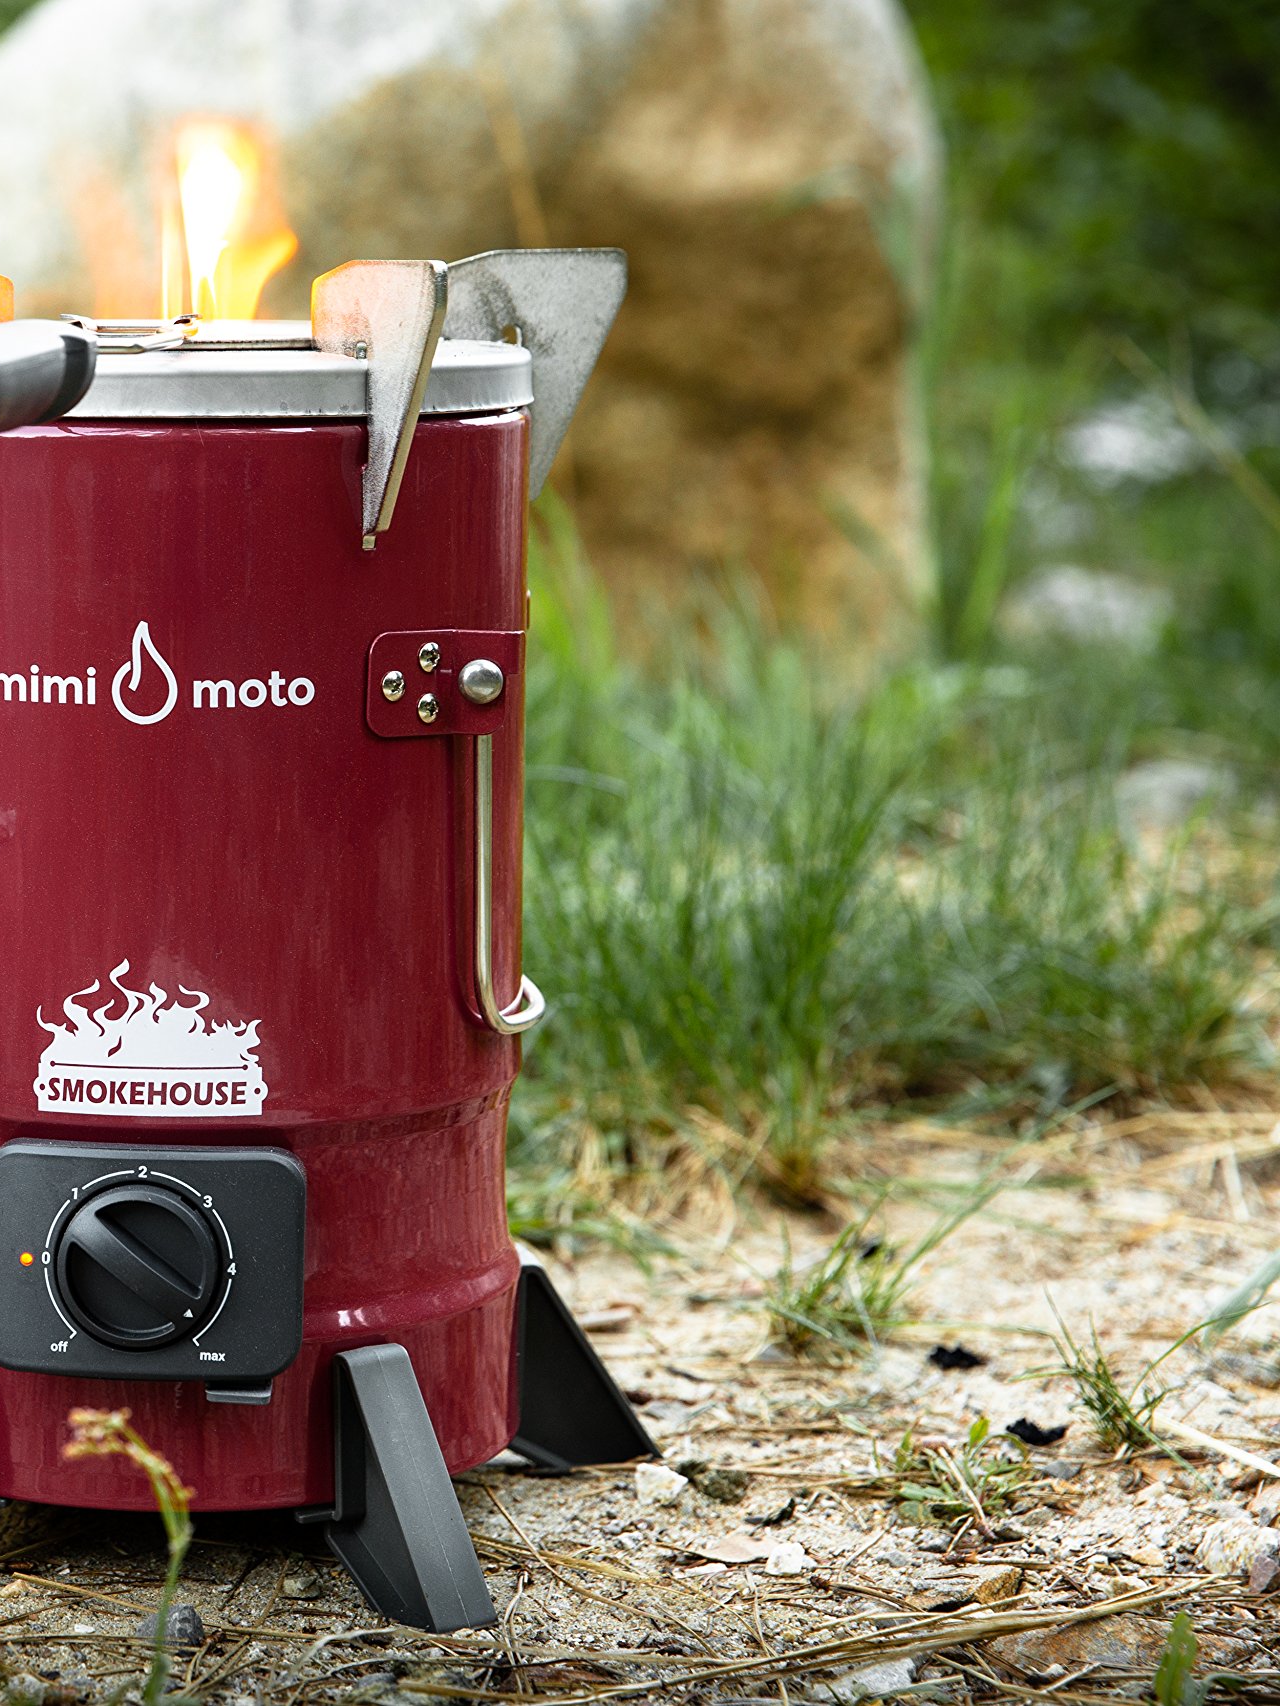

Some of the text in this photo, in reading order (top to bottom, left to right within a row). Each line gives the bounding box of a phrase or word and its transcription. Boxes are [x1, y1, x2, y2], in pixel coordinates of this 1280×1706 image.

[192, 670, 316, 709] moto
[47, 1076, 248, 1106] SMOKEHOUSE
[137, 1165, 149, 1179] 2
[70, 1187, 80, 1200] 1
[202, 1194, 214, 1209] 3
[40, 1251, 51, 1266] 0
[226, 1262, 238, 1276] 4
[49, 1340, 69, 1353] off
[199, 1350, 226, 1363] max
